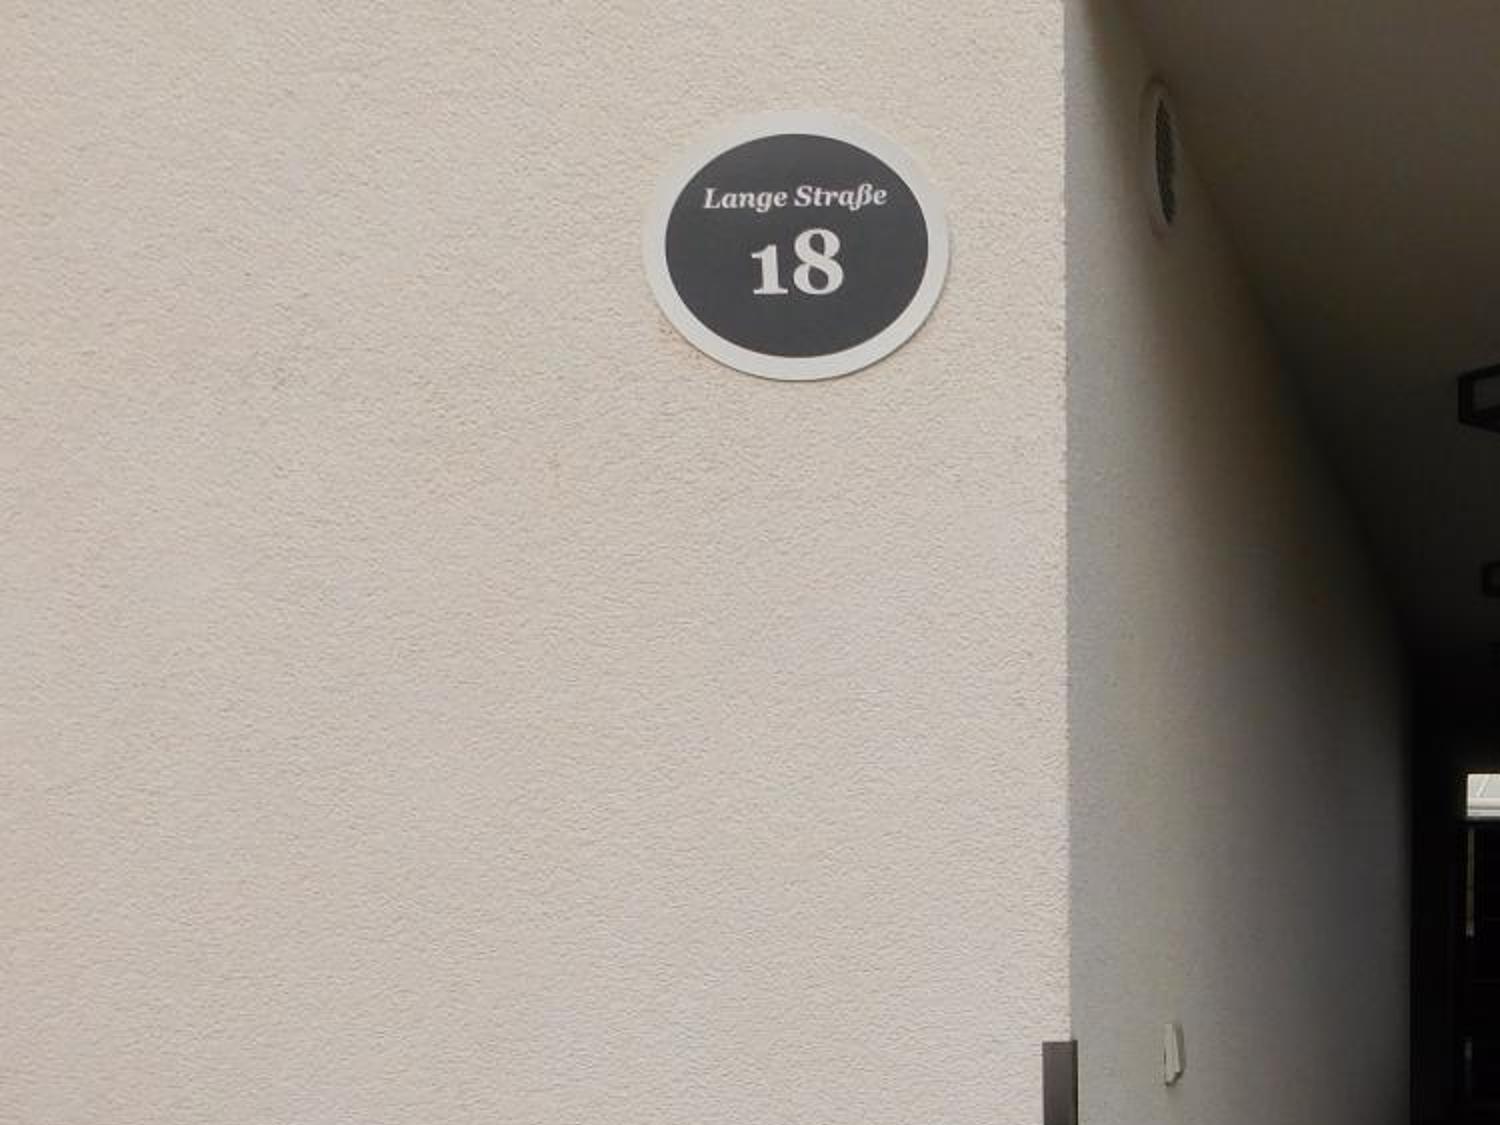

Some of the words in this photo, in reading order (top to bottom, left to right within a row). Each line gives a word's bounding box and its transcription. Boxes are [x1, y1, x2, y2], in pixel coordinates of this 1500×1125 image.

[704, 187, 788, 213] Lange
[793, 183, 888, 212] Straße
[751, 227, 844, 295] 18
